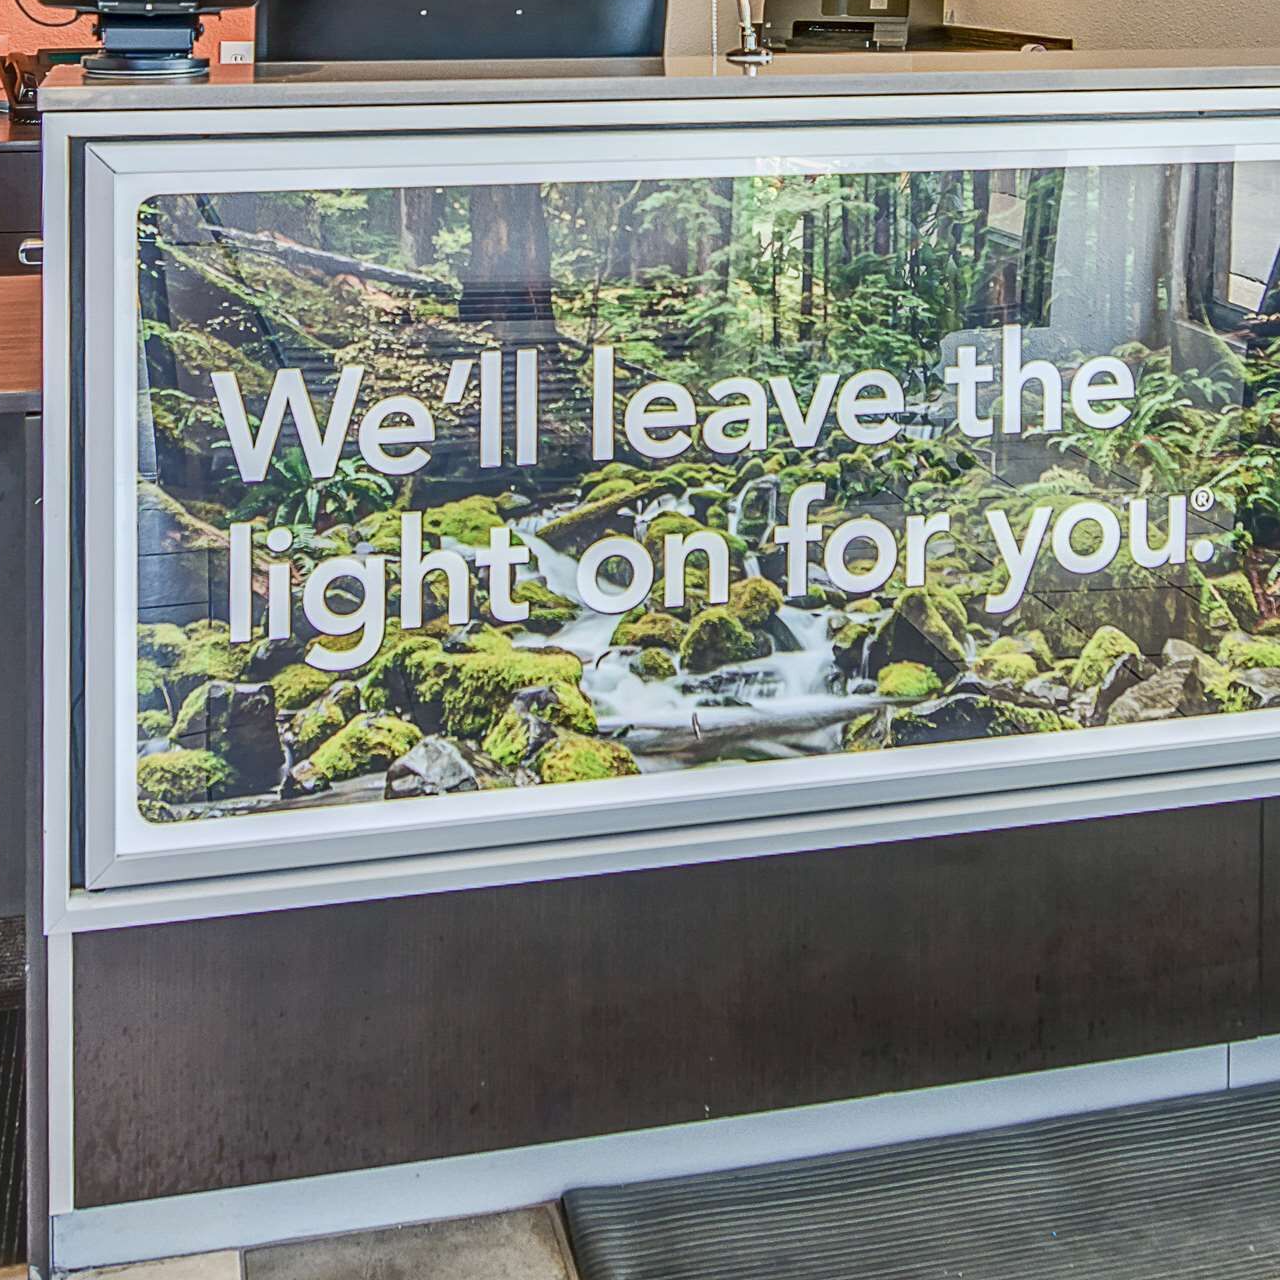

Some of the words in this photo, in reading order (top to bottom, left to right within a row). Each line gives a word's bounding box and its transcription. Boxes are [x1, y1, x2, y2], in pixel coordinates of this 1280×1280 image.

[211, 348, 538, 484] We'll
[591, 344, 906, 462] leave
[943, 324, 1136, 440] the
[228, 511, 532, 673] light
[576, 529, 730, 616] on
[773, 481, 951, 599] for
